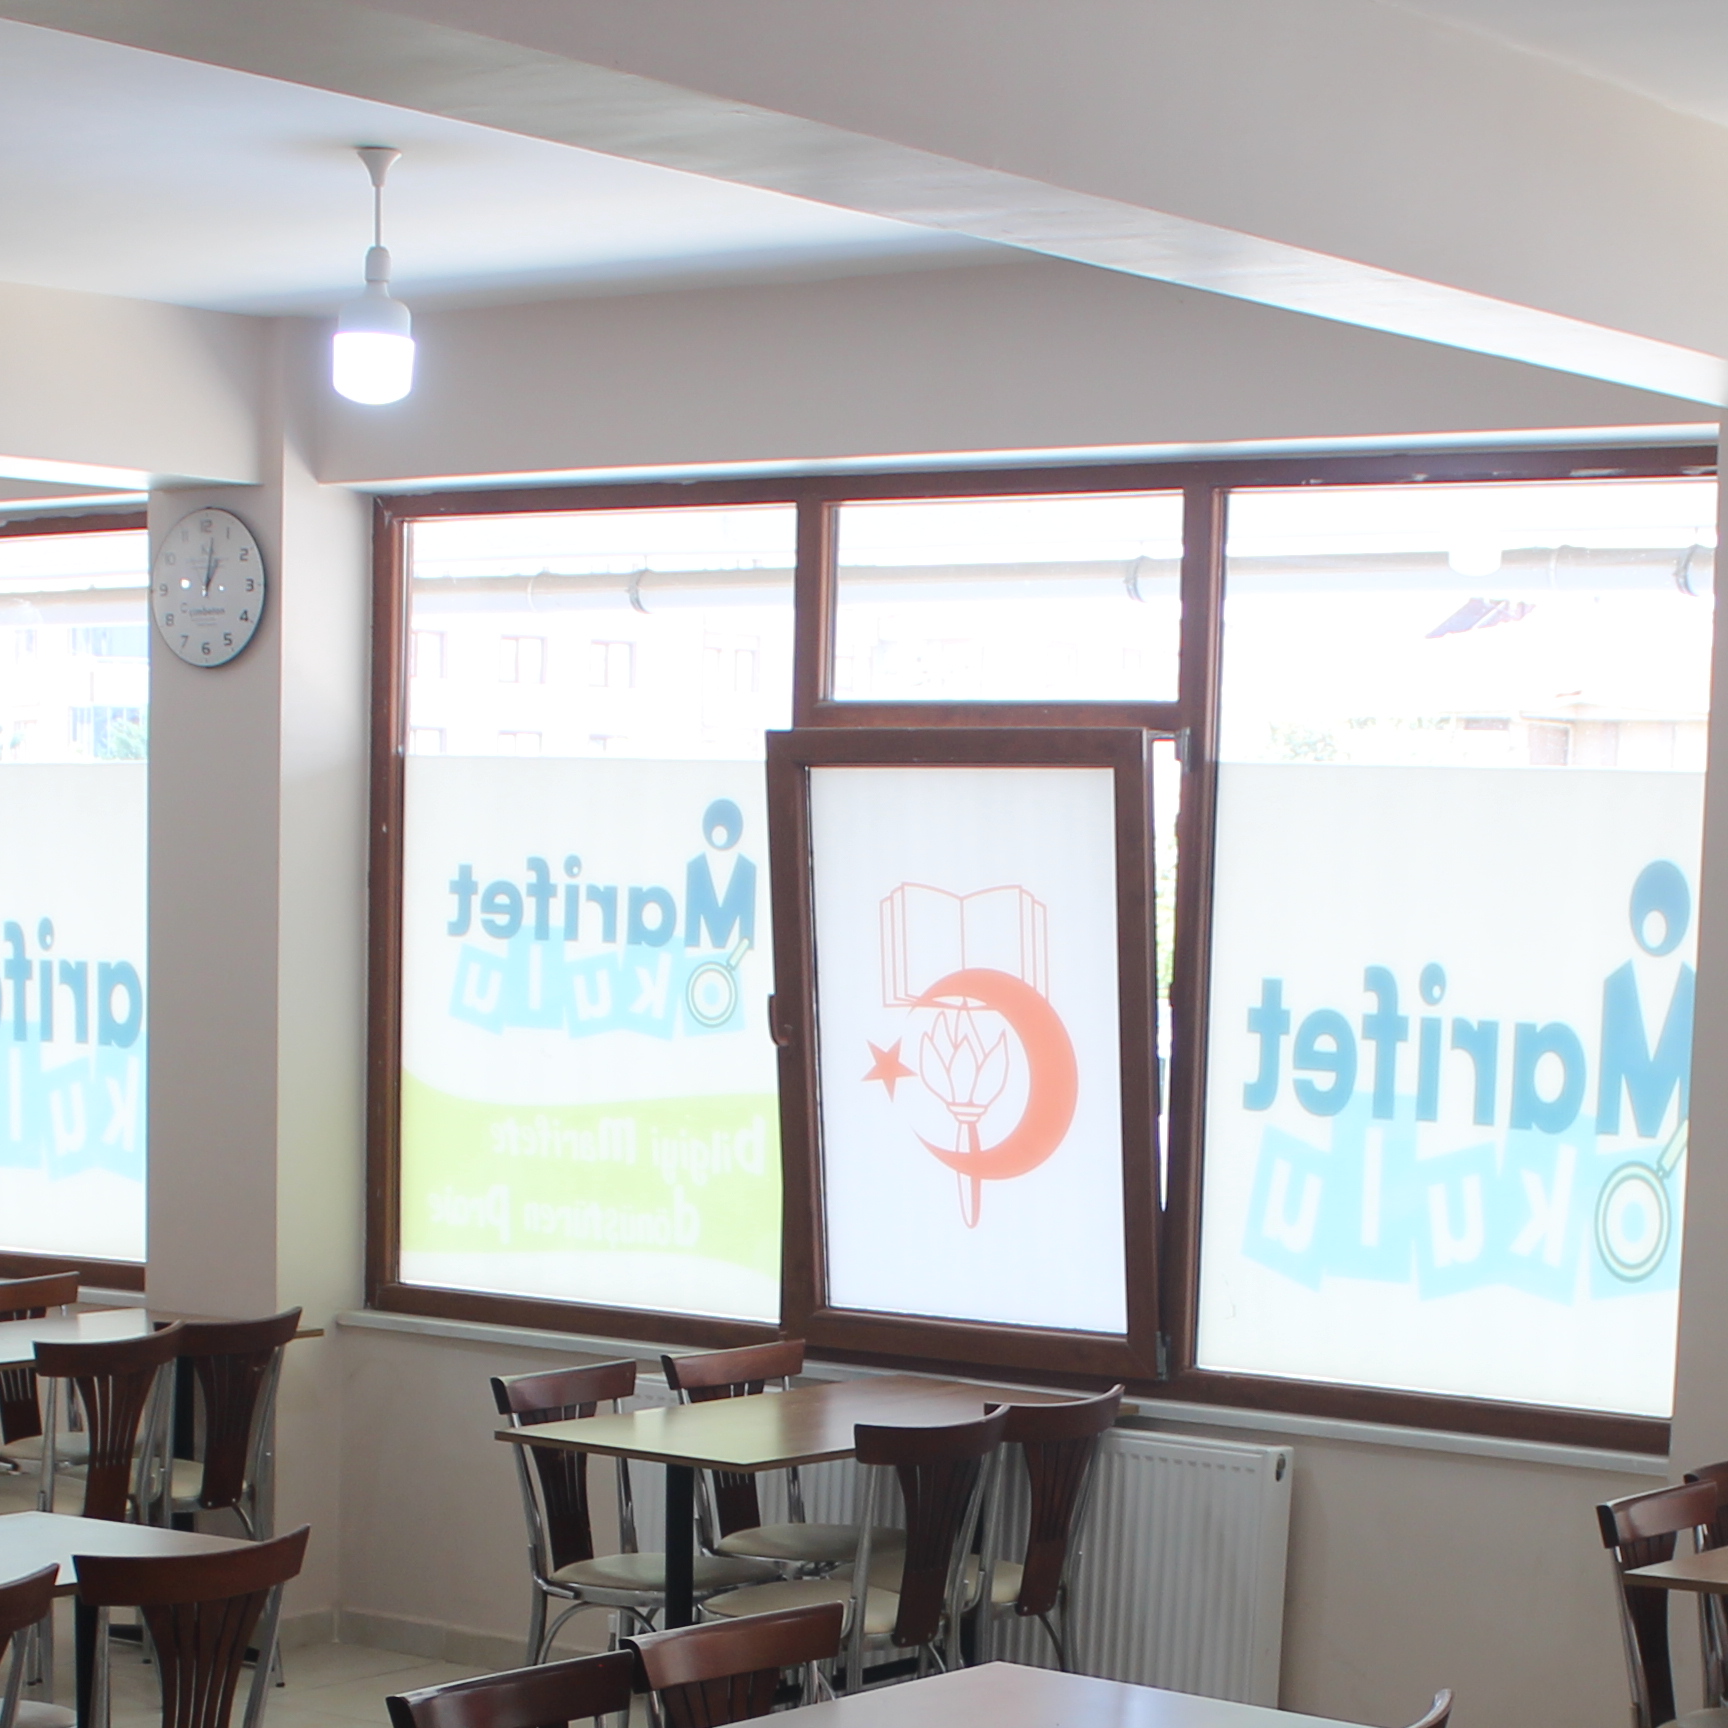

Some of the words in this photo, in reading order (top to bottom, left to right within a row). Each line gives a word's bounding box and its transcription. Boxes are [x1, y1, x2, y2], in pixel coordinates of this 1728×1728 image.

[200, 519, 213, 533] 12
[164, 552, 176, 566] 10
[239, 547, 249, 562] 2
[159, 584, 168, 597] 9
[245, 578, 255, 593] 3
[165, 613, 175, 627] 8
[239, 609, 249, 622] 4
[180, 634, 189, 648] 7
[223, 632, 233, 647] 5
[201, 641, 211, 655] 6
